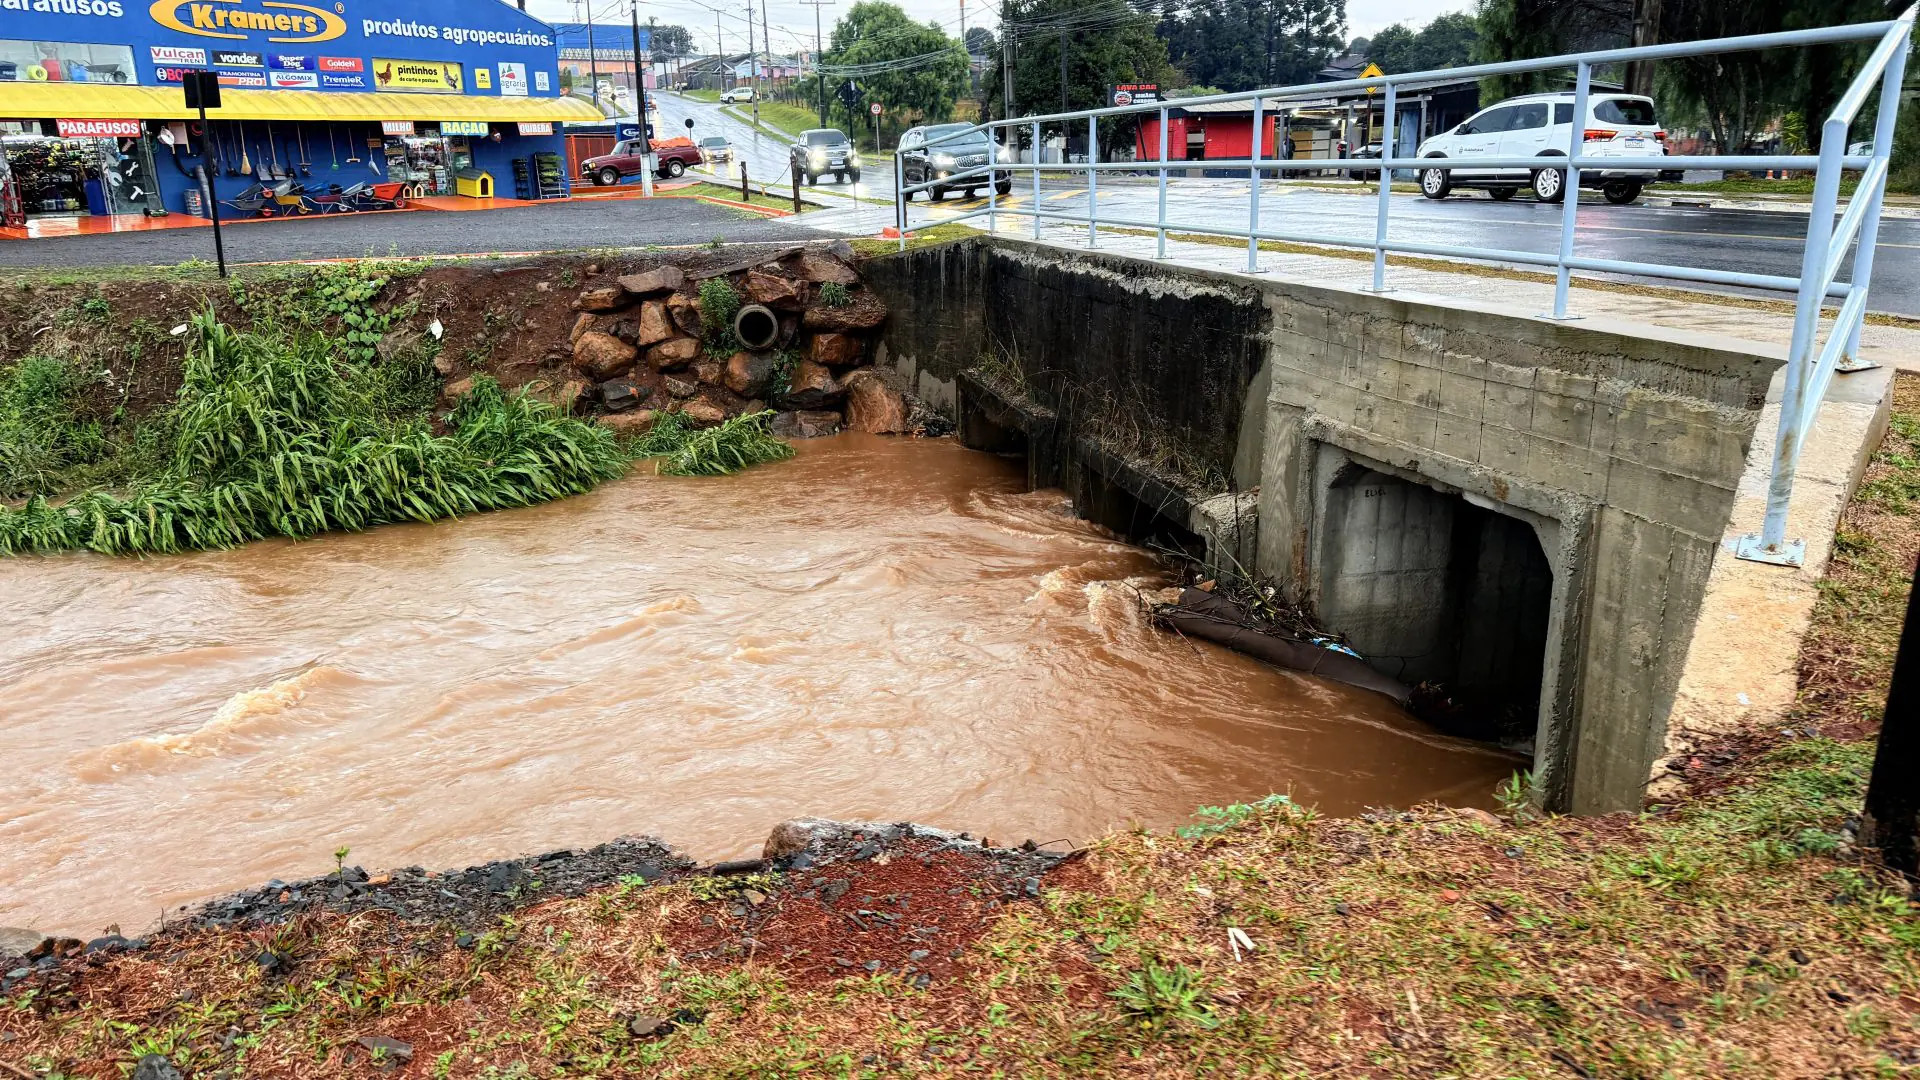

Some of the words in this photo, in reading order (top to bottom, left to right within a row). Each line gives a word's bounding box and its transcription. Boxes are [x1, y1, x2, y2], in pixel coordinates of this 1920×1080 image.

[0, 0, 124, 17] arafusos
[190, 3, 318, 33] Kramers
[362, 18, 439, 38] produtos
[151, 47, 205, 59] Vulcan
[397, 65, 438, 76] pintinhos
[238, 77, 263, 85] PRO
[59, 121, 139, 134] PARAFUSOS
[383, 122, 412, 132] MILHO
